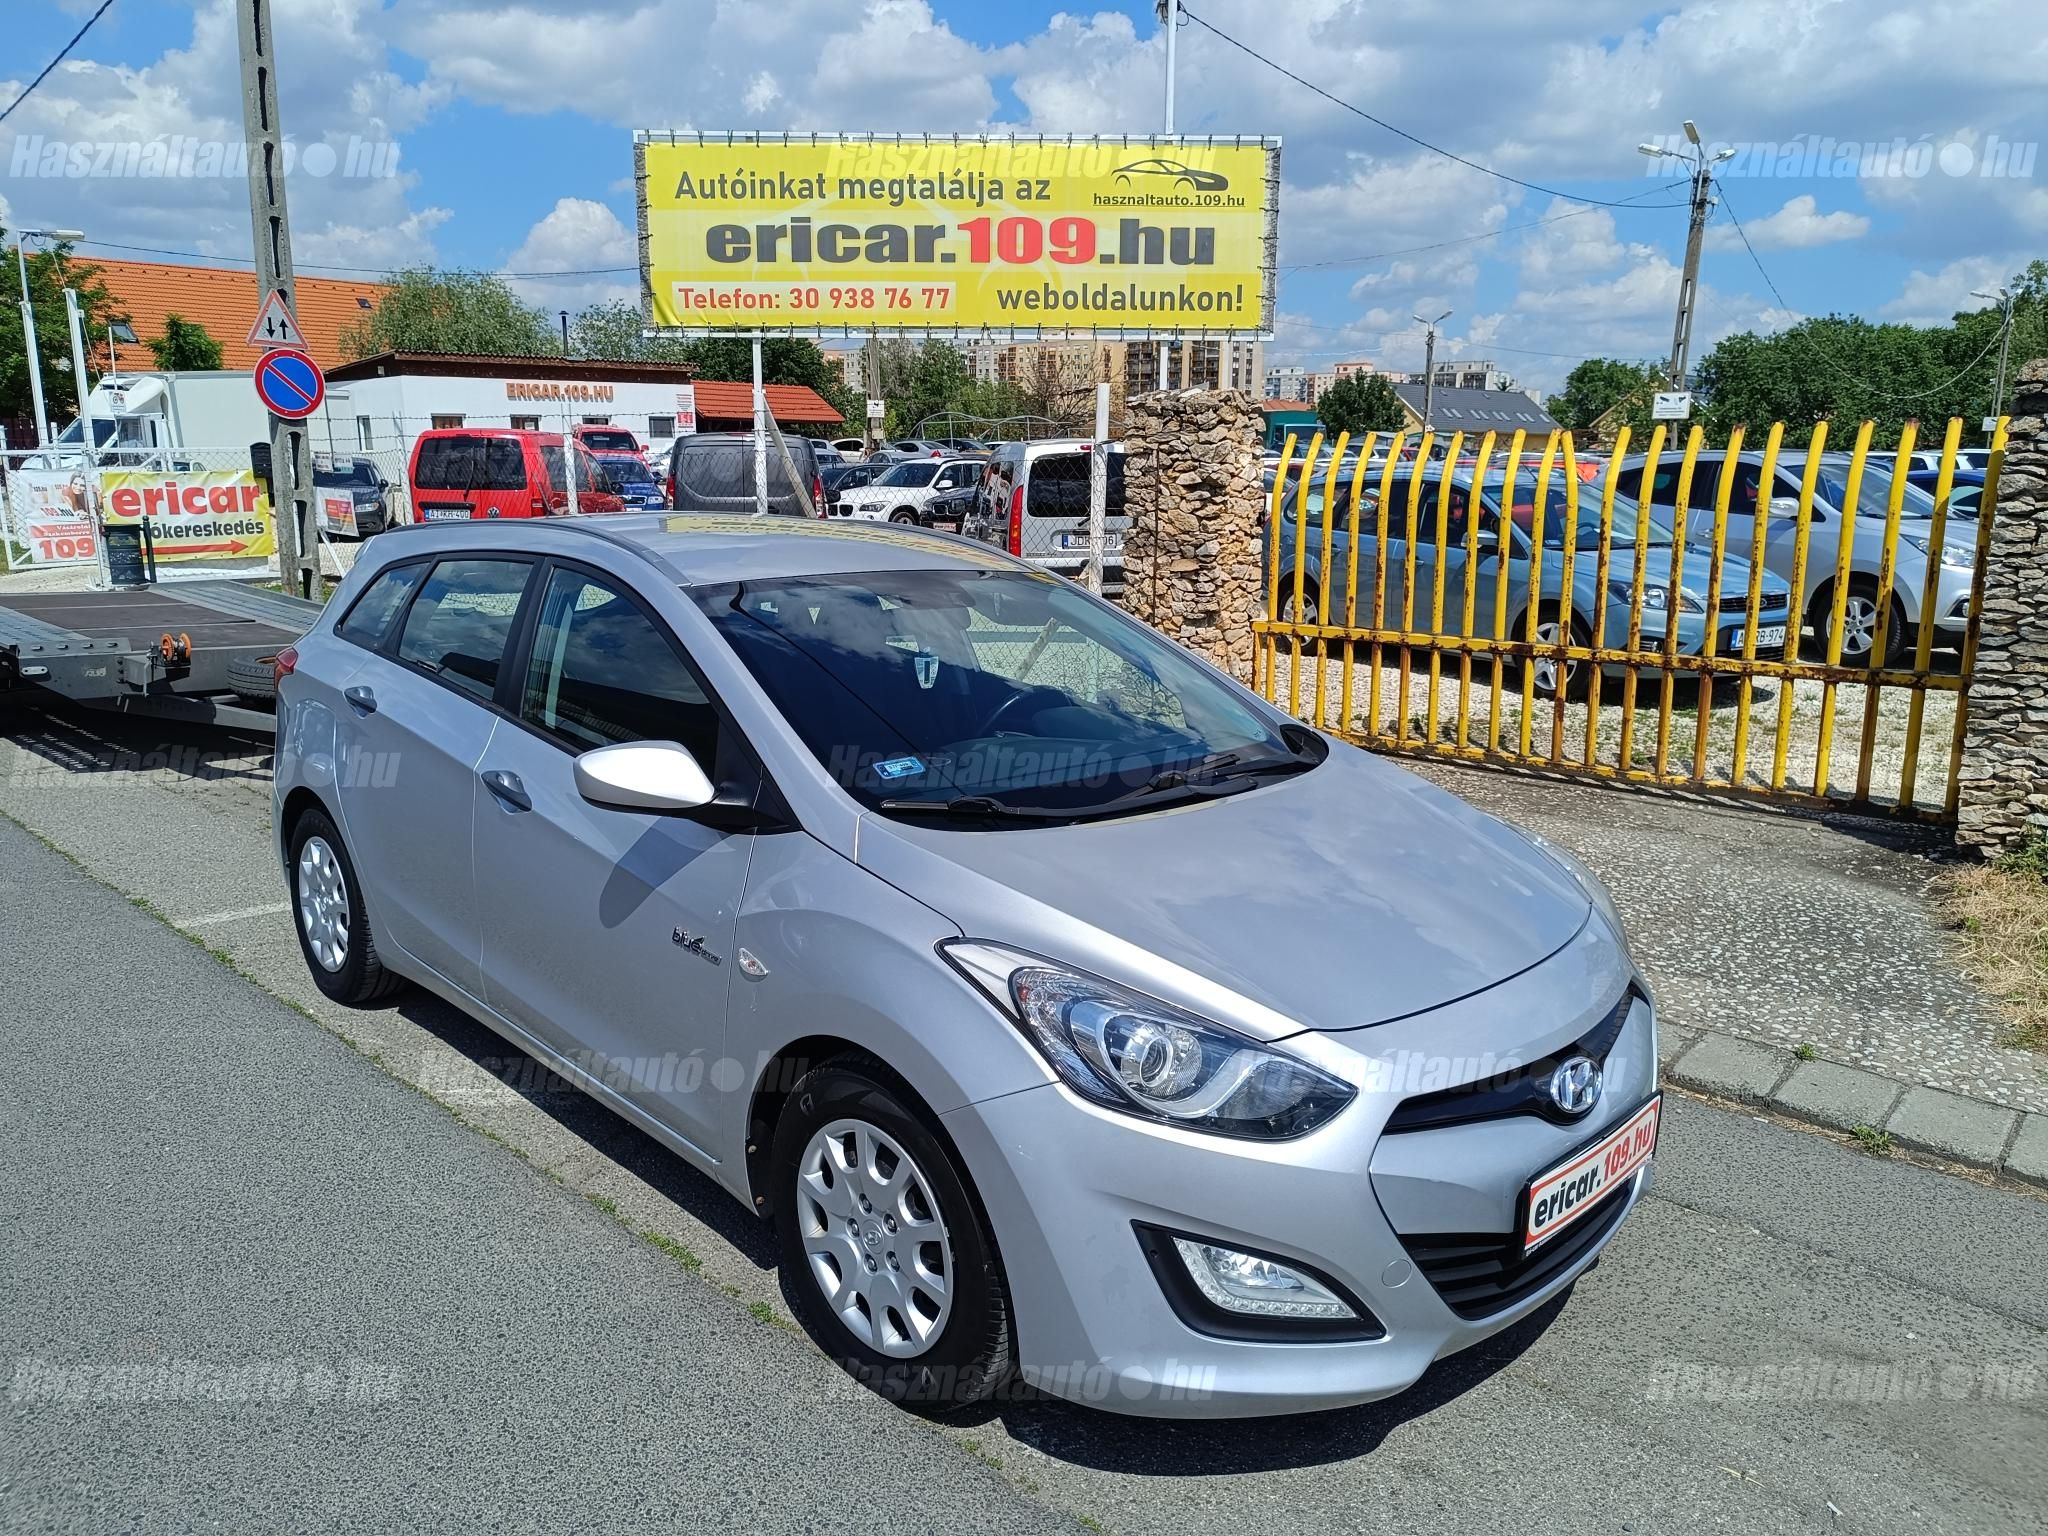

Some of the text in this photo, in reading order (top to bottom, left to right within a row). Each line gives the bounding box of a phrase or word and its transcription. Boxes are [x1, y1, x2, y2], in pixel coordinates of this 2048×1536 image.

[675, 168, 1051, 207] Autóinkat megtalálja az
[1093, 193, 1245, 207] hasznaltauto.109.hu
[706, 216, 1215, 265] ericar.109.hu
[678, 287, 950, 309] Telefon: 30 938 76 77
[997, 282, 1243, 312] weboldalunkon!
[506, 383, 614, 402] ERICAR.109.HU
[111, 482, 260, 517] ericar
[151, 520, 264, 539] ókereskedés
[39, 537, 96, 559] 109
[1534, 1119, 1652, 1228] ericar.109.hu
